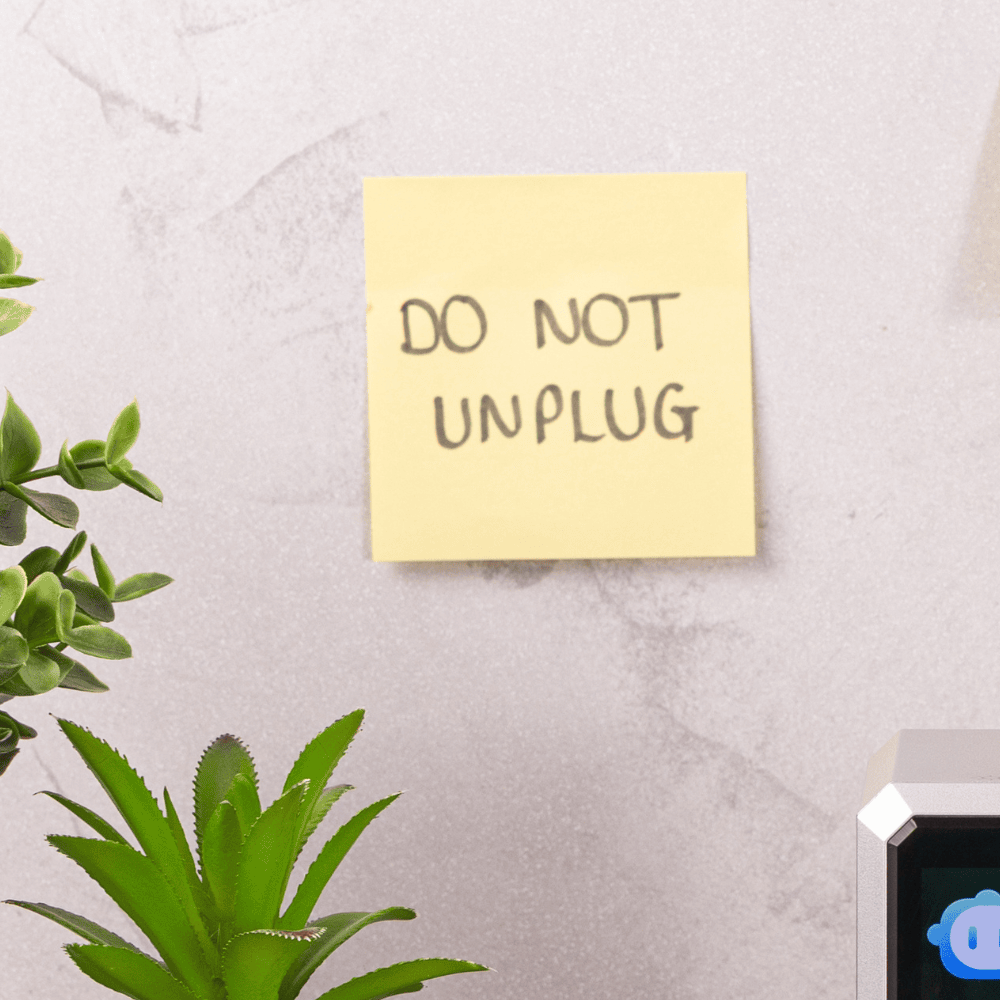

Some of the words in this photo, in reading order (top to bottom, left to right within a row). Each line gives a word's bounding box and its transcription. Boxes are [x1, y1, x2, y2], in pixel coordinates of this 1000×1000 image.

[400, 294, 488, 356] DO
[533, 292, 681, 352] NOT
[433, 382, 700, 450] UNPLUG
